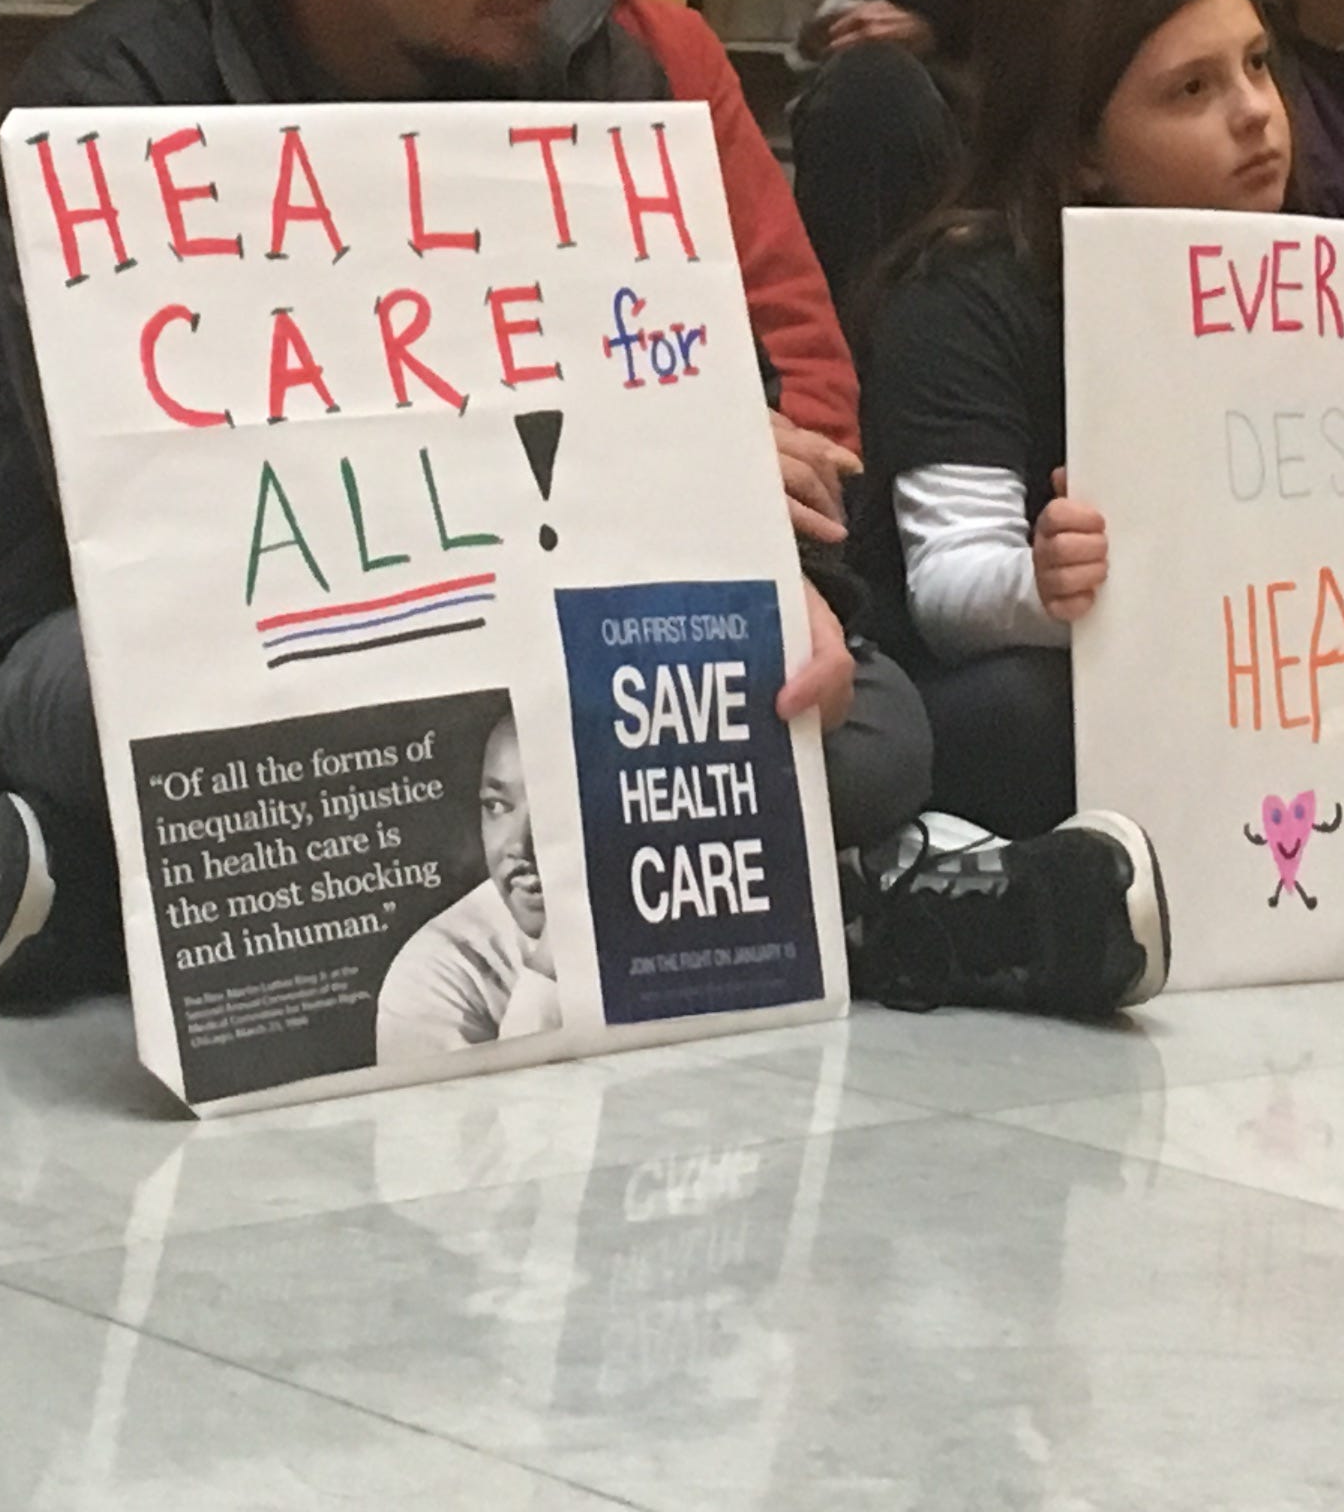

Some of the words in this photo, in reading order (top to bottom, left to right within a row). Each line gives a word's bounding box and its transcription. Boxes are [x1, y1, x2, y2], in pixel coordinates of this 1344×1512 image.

[25, 122, 701, 288] HEALTH
[139, 282, 565, 429] CARE
[602, 287, 707, 389] for
[602, 618, 641, 646] OUR
[642, 615, 686, 644] FIRST
[612, 661, 750, 749] SAVE
[211, 760, 249, 794] all
[256, 756, 304, 787] the
[313, 744, 398, 778] forms
[406, 730, 436, 761] of
[619, 761, 758, 824] HEALTH
[157, 799, 313, 845] inequality,
[321, 776, 445, 821] injustice
[161, 857, 194, 887] in
[201, 839, 298, 880] health
[306, 832, 370, 862] care
[376, 821, 402, 849] is
[631, 838, 770, 924] CARE
[166, 896, 218, 929] the
[227, 881, 304, 918] most
[310, 859, 442, 902] shocking
[176, 931, 236, 970] and
